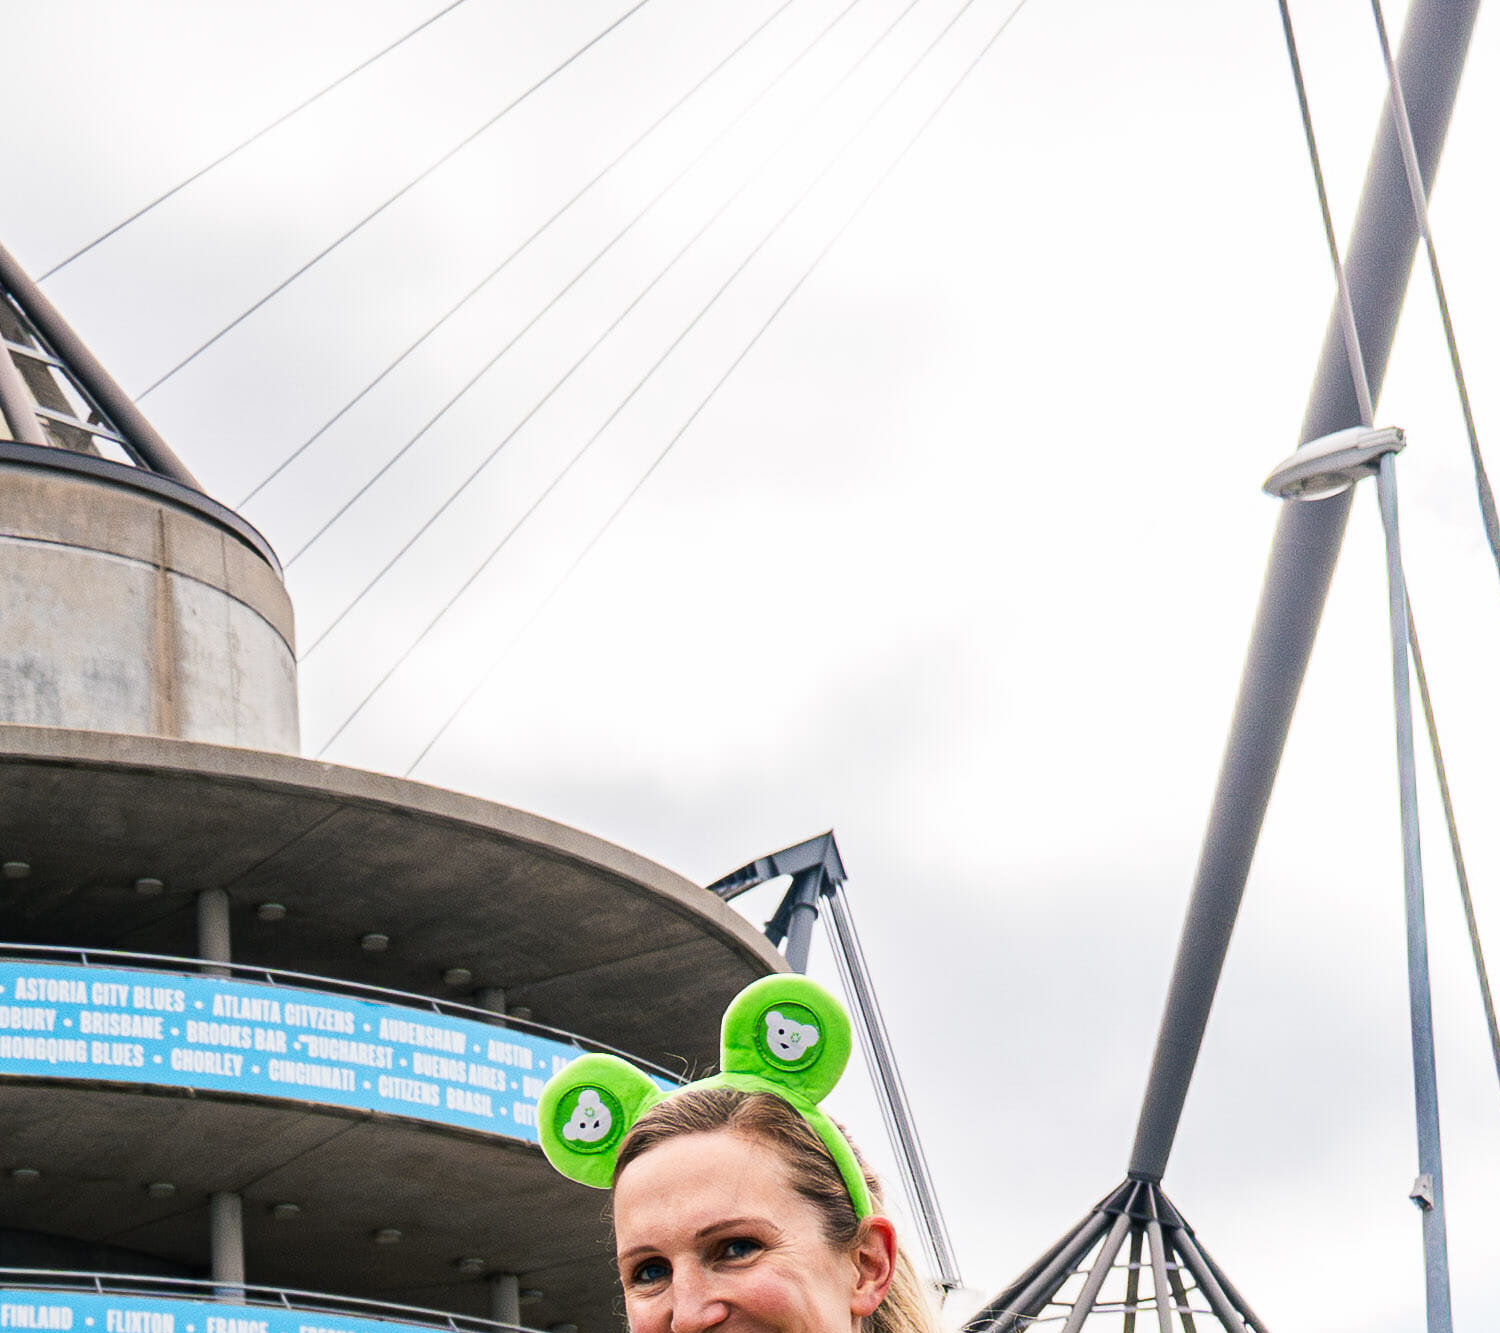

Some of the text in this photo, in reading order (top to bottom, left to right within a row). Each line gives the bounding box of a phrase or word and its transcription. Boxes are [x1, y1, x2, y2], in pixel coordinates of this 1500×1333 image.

[15, 977, 87, 1004] ASTORIA
[92, 982, 128, 1007] CITY
[133, 986, 185, 1012] BLUES
[213, 994, 281, 1023] ATLANTA
[285, 1003, 354, 1034] CITYZENS
[379, 1018, 466, 1054] AUDENSHAW
[488, 1040, 532, 1070] AUSTIN
[80, 1011, 163, 1040] BRISBANE
[187, 1020, 252, 1049] BROOKS
[255, 1028, 286, 1053] BAR
[306, 1035, 393, 1069] BUCHAREST
[413, 1052, 469, 1083] BUENOS
[468, 1064, 506, 1091] AIRES
[92, 1041, 144, 1067] BLUES
[171, 1048, 243, 1077] CHORLEY
[269, 1059, 355, 1092] CINCINNATI
[446, 1087, 492, 1117] BRASIL
[1, 1304, 73, 1330] FINLAND
